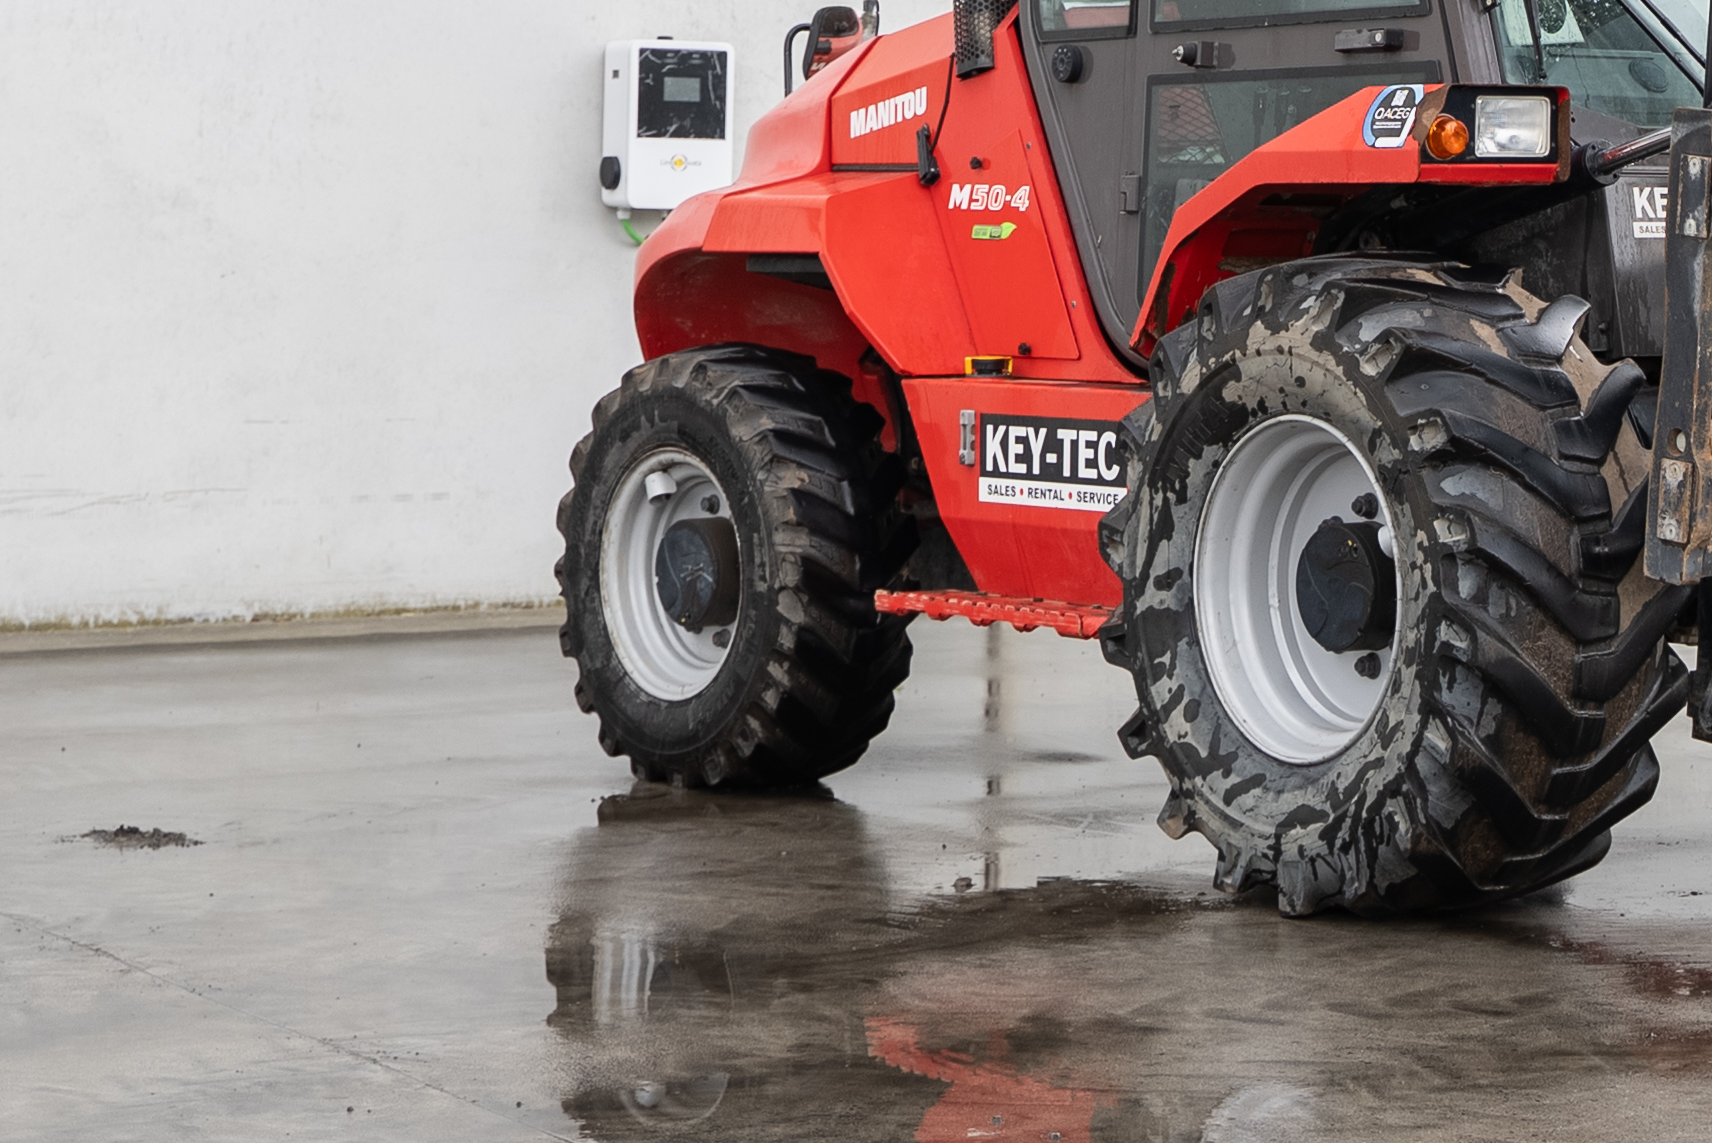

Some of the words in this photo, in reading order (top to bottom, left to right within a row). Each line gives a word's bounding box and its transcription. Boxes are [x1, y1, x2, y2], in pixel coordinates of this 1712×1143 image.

[850, 86, 927, 139] MANITOU
[985, 424, 1121, 482] KEY-TEC
[987, 483, 1017, 498] SALES
[1027, 487, 1065, 502] RENTAL
[1076, 491, 1120, 506] SERVICE
